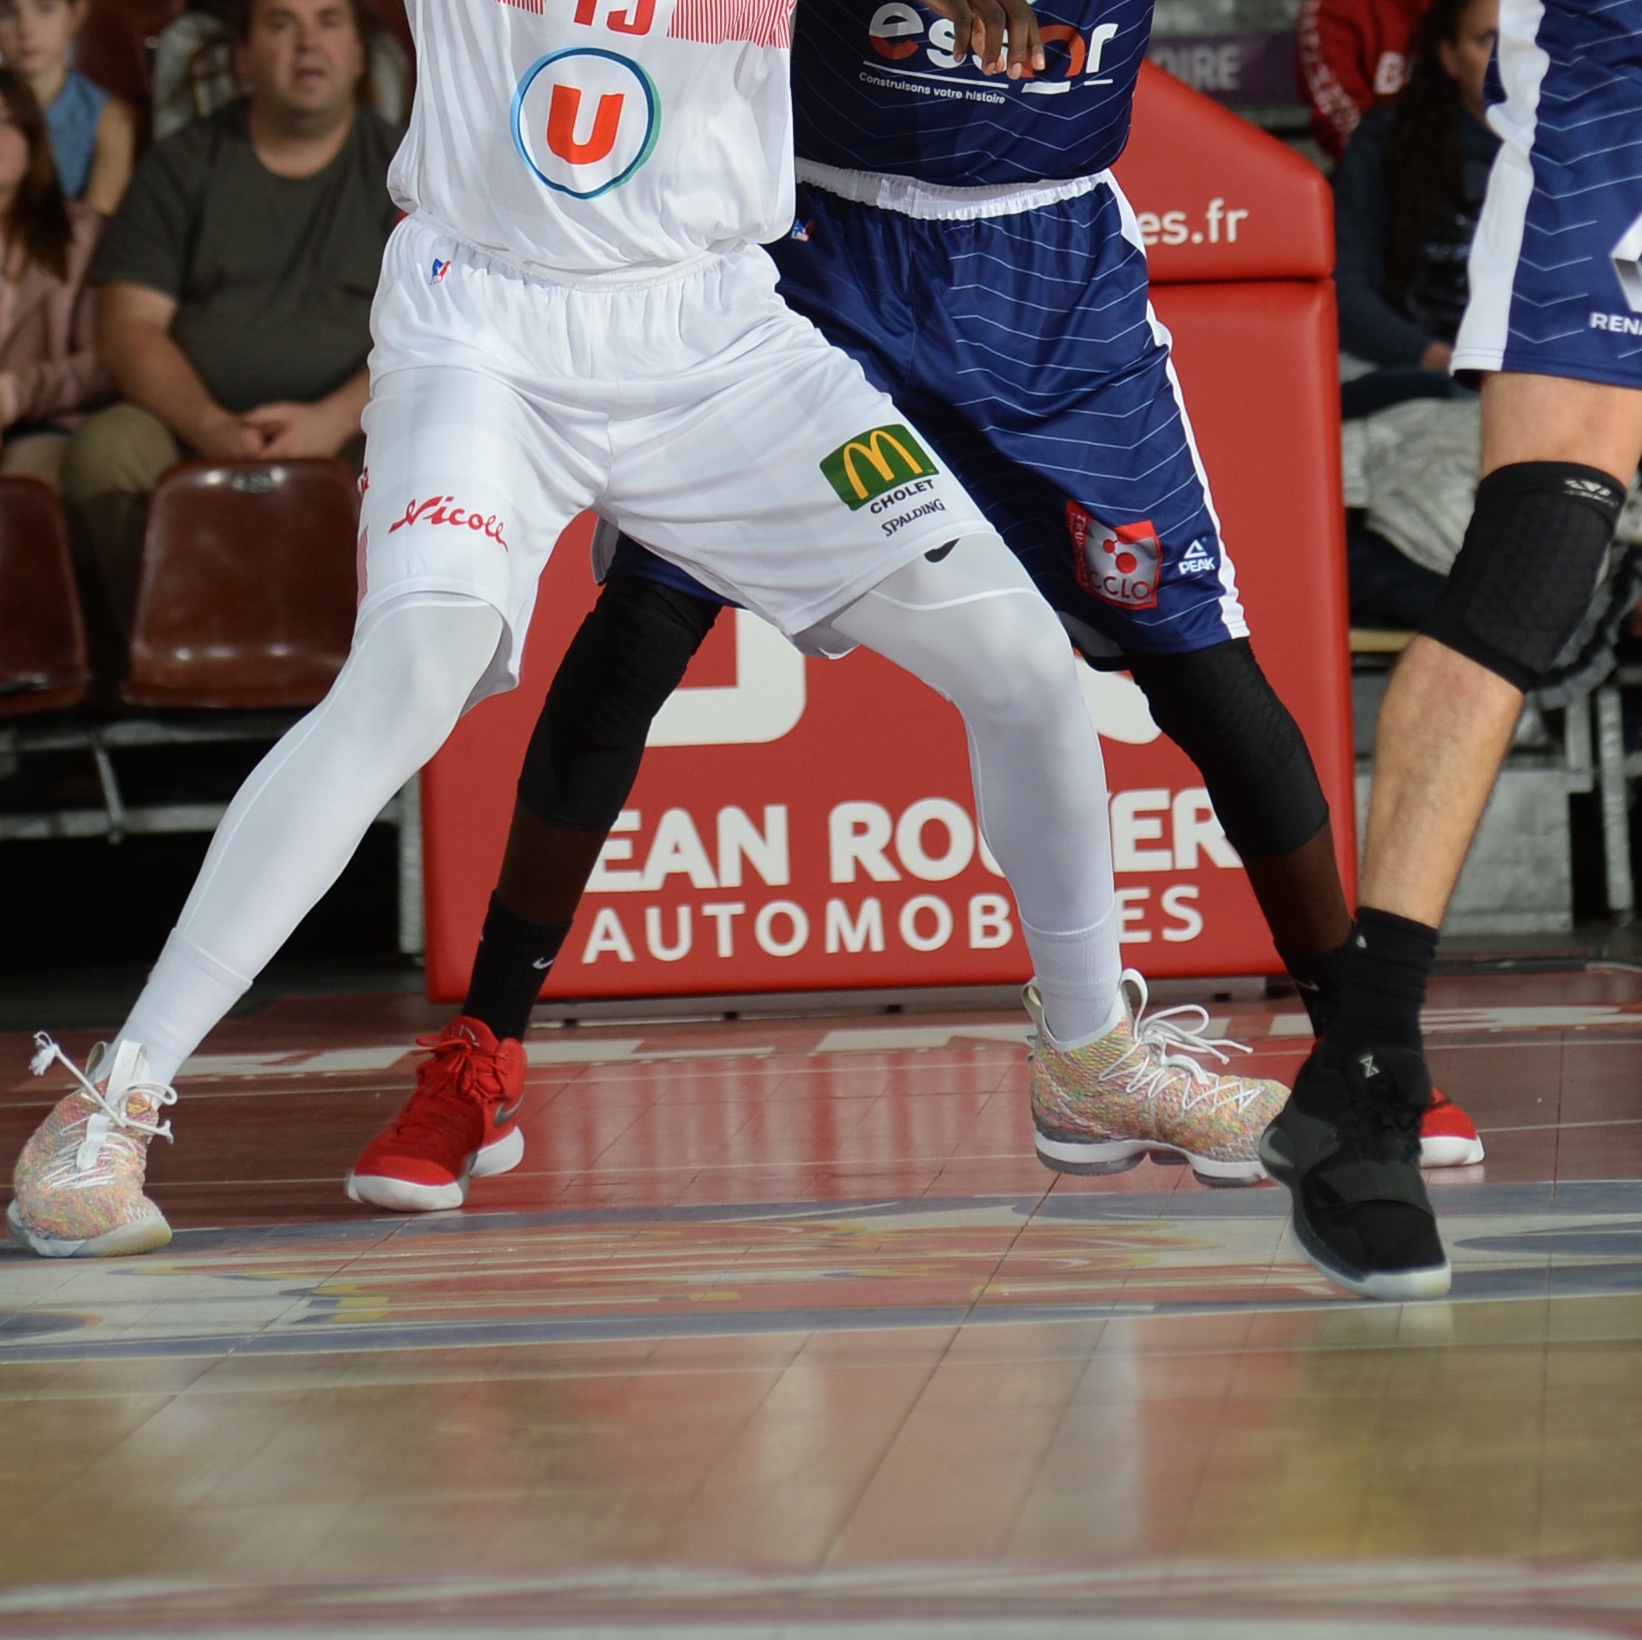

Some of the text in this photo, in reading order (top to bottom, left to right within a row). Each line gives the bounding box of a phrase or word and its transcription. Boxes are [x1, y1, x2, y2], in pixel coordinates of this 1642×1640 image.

[859, 72, 1006, 105] Construisons votre histoire
[546, 83, 625, 165] U
[1136, 197, 1249, 246] es.fr
[869, 478, 935, 514] CHOLET
[881, 498, 947, 538] SPALDING
[388, 495, 509, 553] Nicoll
[1177, 555, 1217, 576] PEAK
[583, 788, 1244, 893] EAN ROER
[581, 884, 1204, 964] AUTOMOBES
